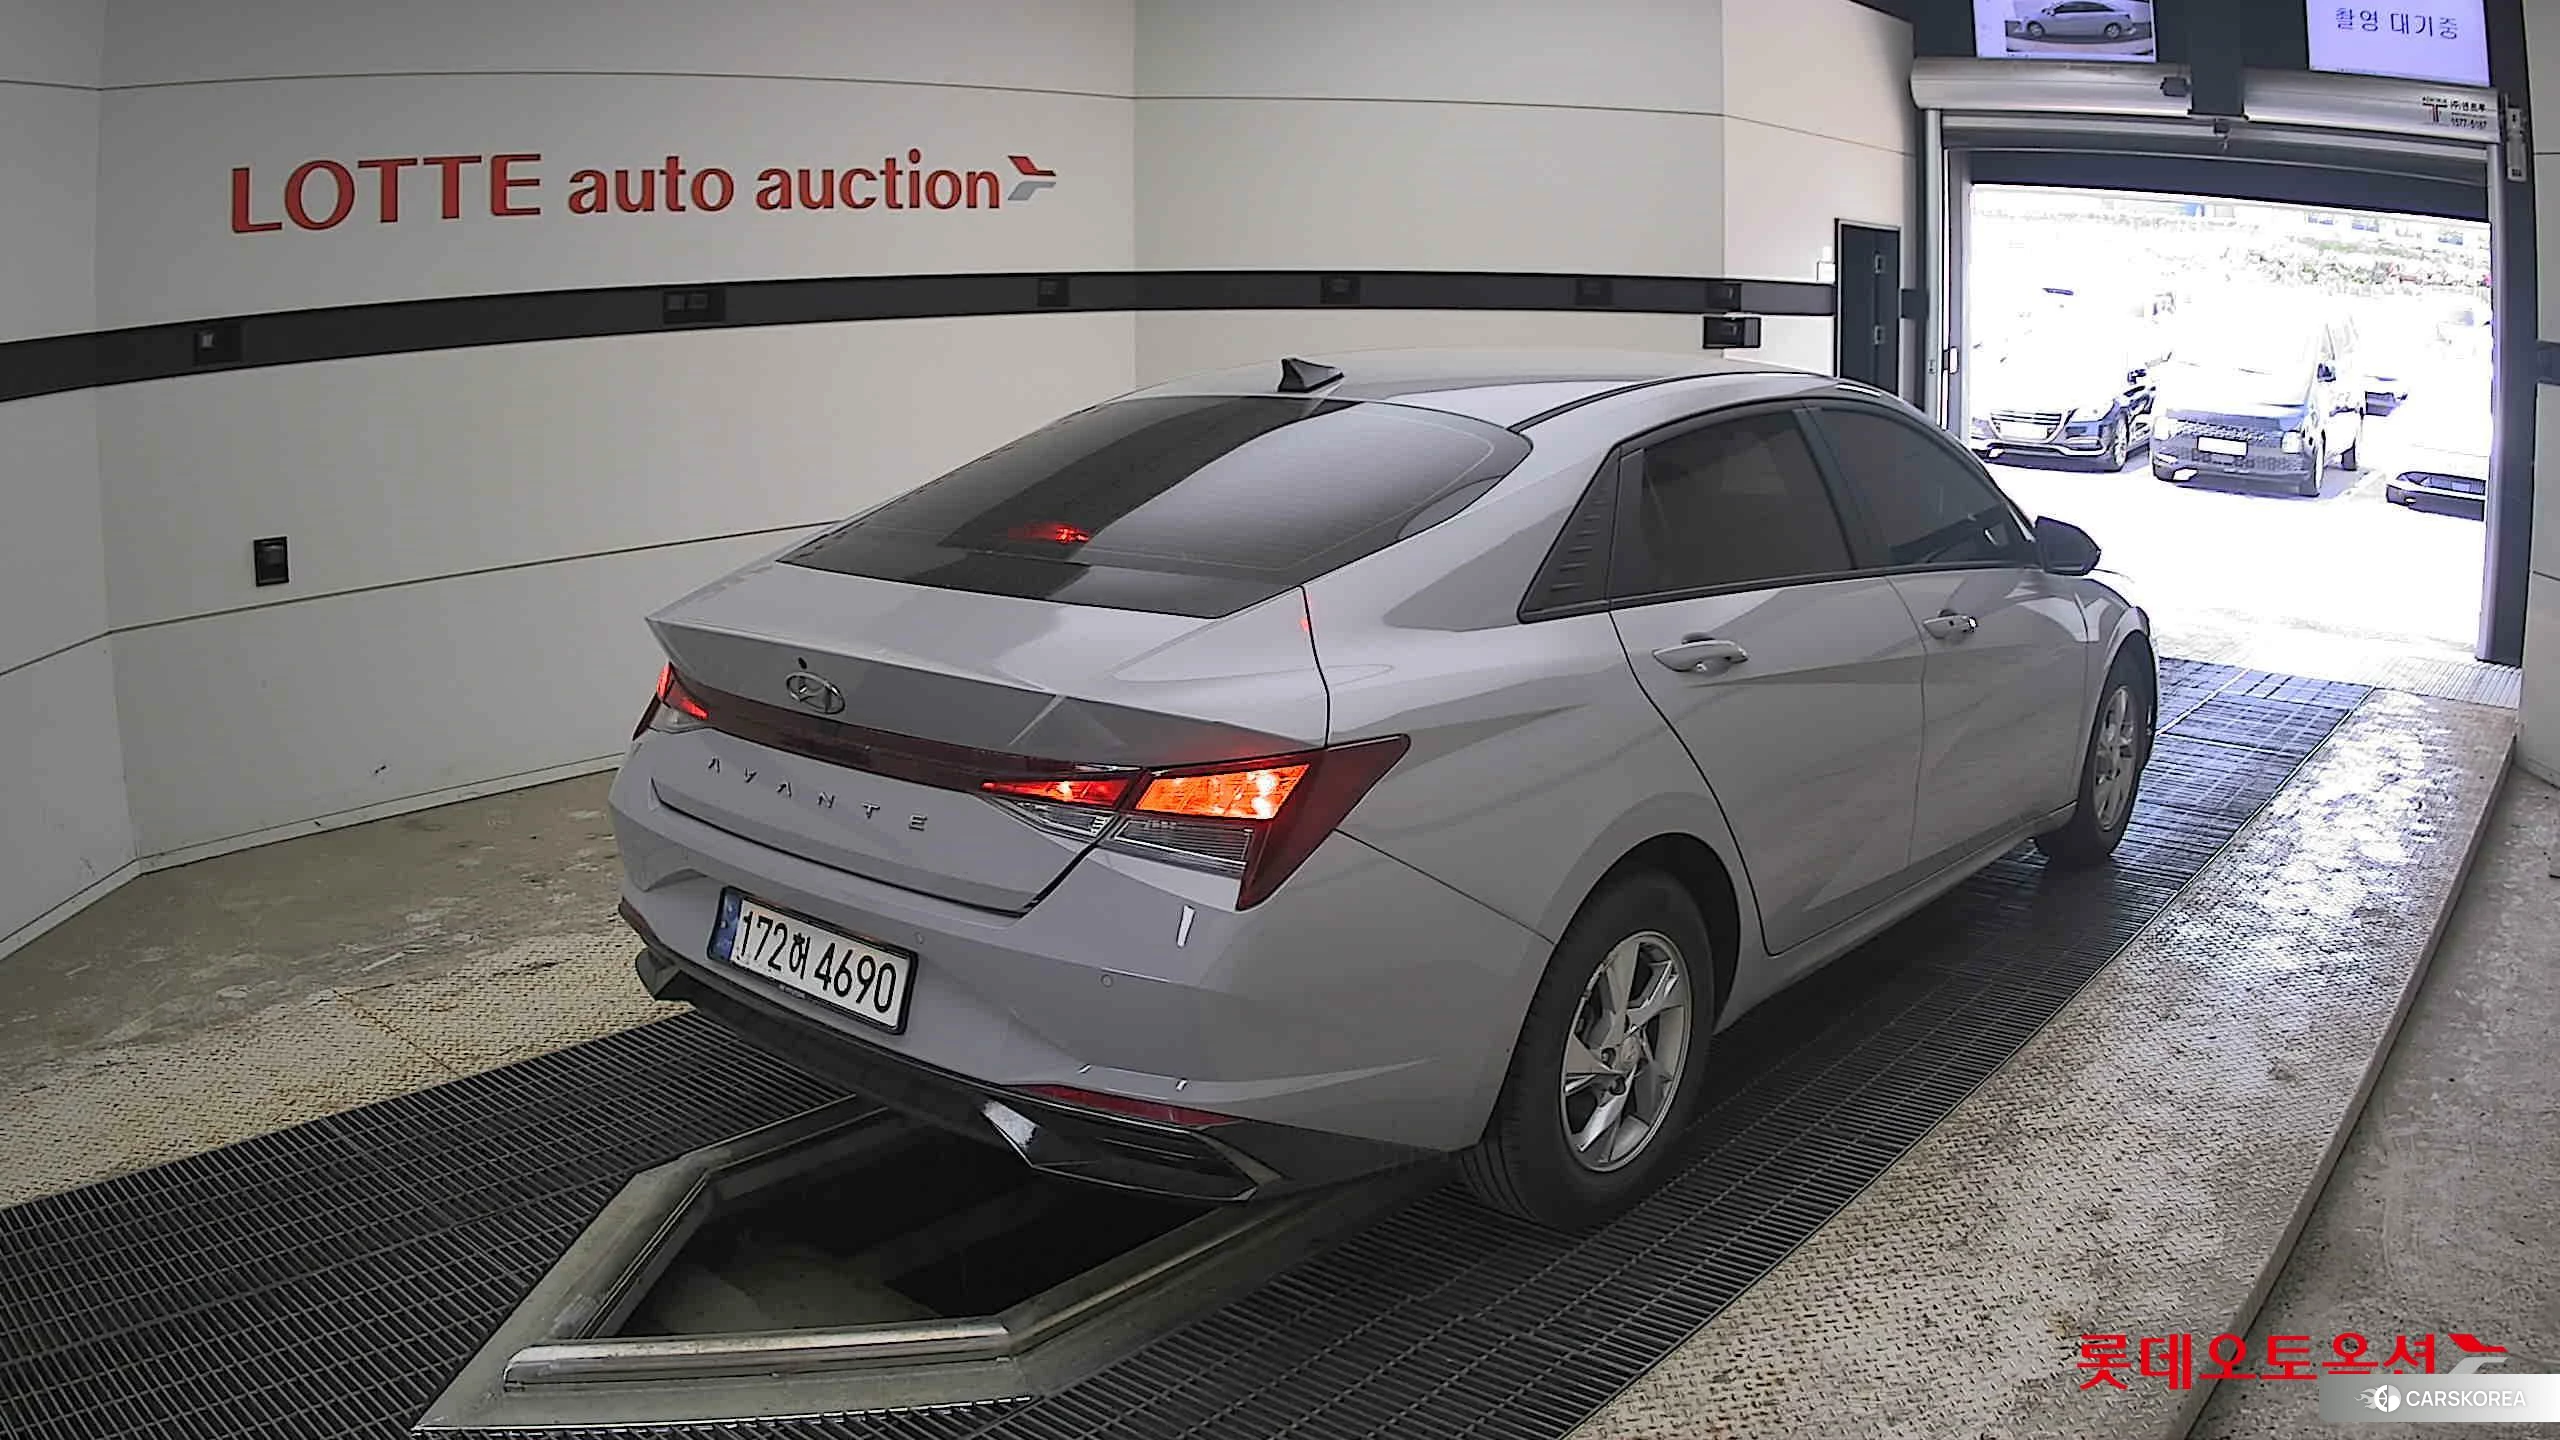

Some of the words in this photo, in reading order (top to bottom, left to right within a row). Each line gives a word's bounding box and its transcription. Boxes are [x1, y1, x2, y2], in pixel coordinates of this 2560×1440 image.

[2336, 7, 2379, 32] 촬영
[2390, 13, 2458, 40] 대기중
[231, 153, 542, 233] LOTTE
[568, 156, 735, 214] auto
[756, 148, 1001, 211] auction
[708, 756, 928, 831] AVANTE
[741, 910, 811, 980] 172허
[814, 942, 897, 1013] 4690
